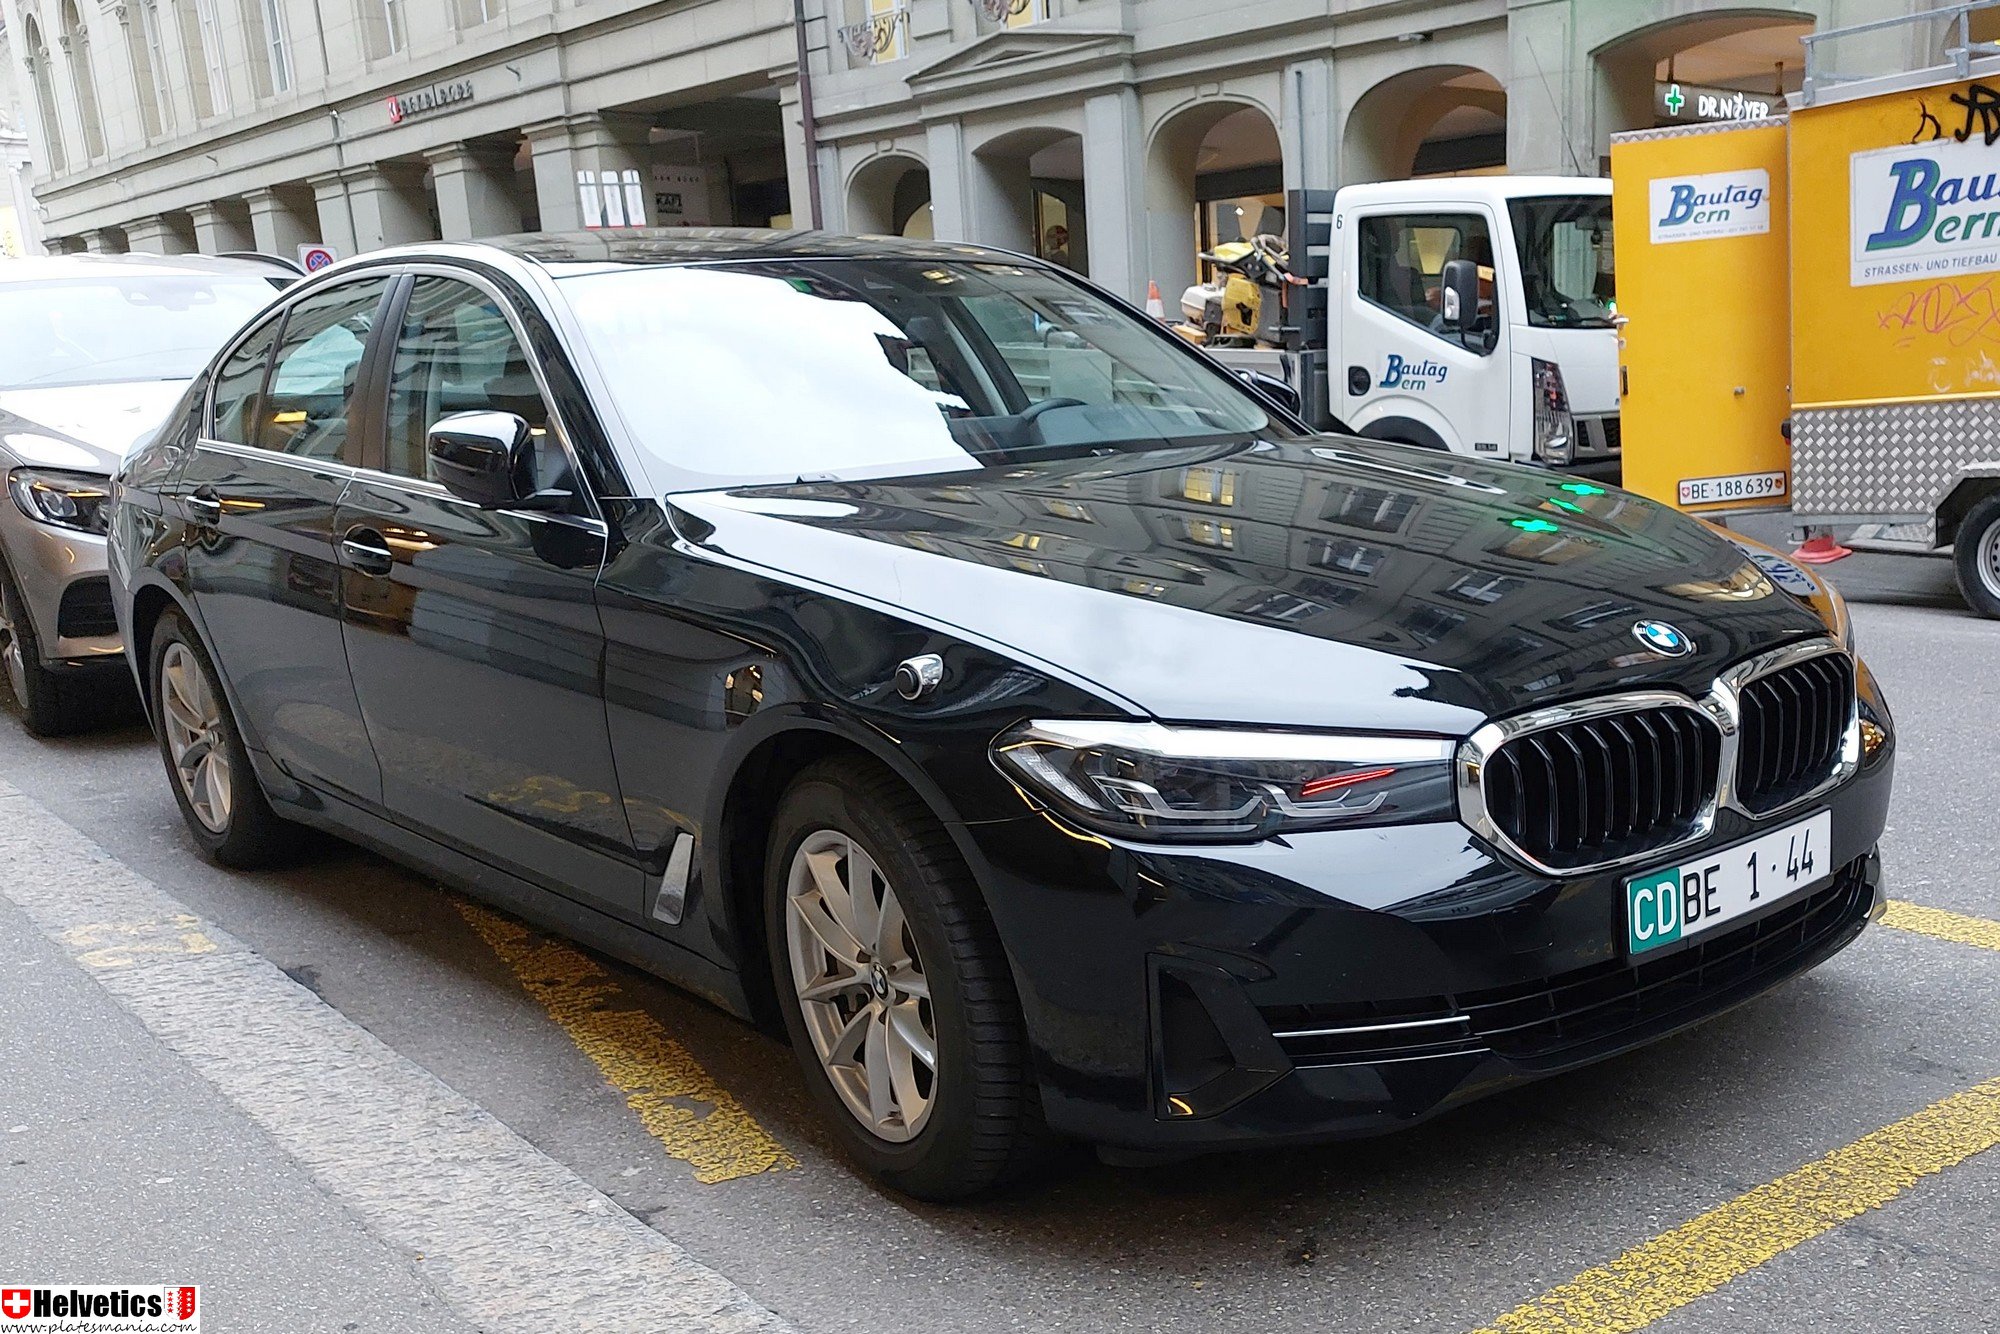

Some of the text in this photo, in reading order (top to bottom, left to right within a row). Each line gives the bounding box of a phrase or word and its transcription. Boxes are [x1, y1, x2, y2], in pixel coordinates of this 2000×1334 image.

[1336, 214, 1343, 229] 6
[1658, 184, 1763, 228] Bautag
[1866, 159, 2000, 251] Bau
[1926, 258, 1950, 271] UND
[1952, 253, 1998, 268] TIEFBAU
[1379, 353, 1448, 388] Bautag
[1633, 881, 1678, 941] CD
[1683, 863, 1721, 926] BE
